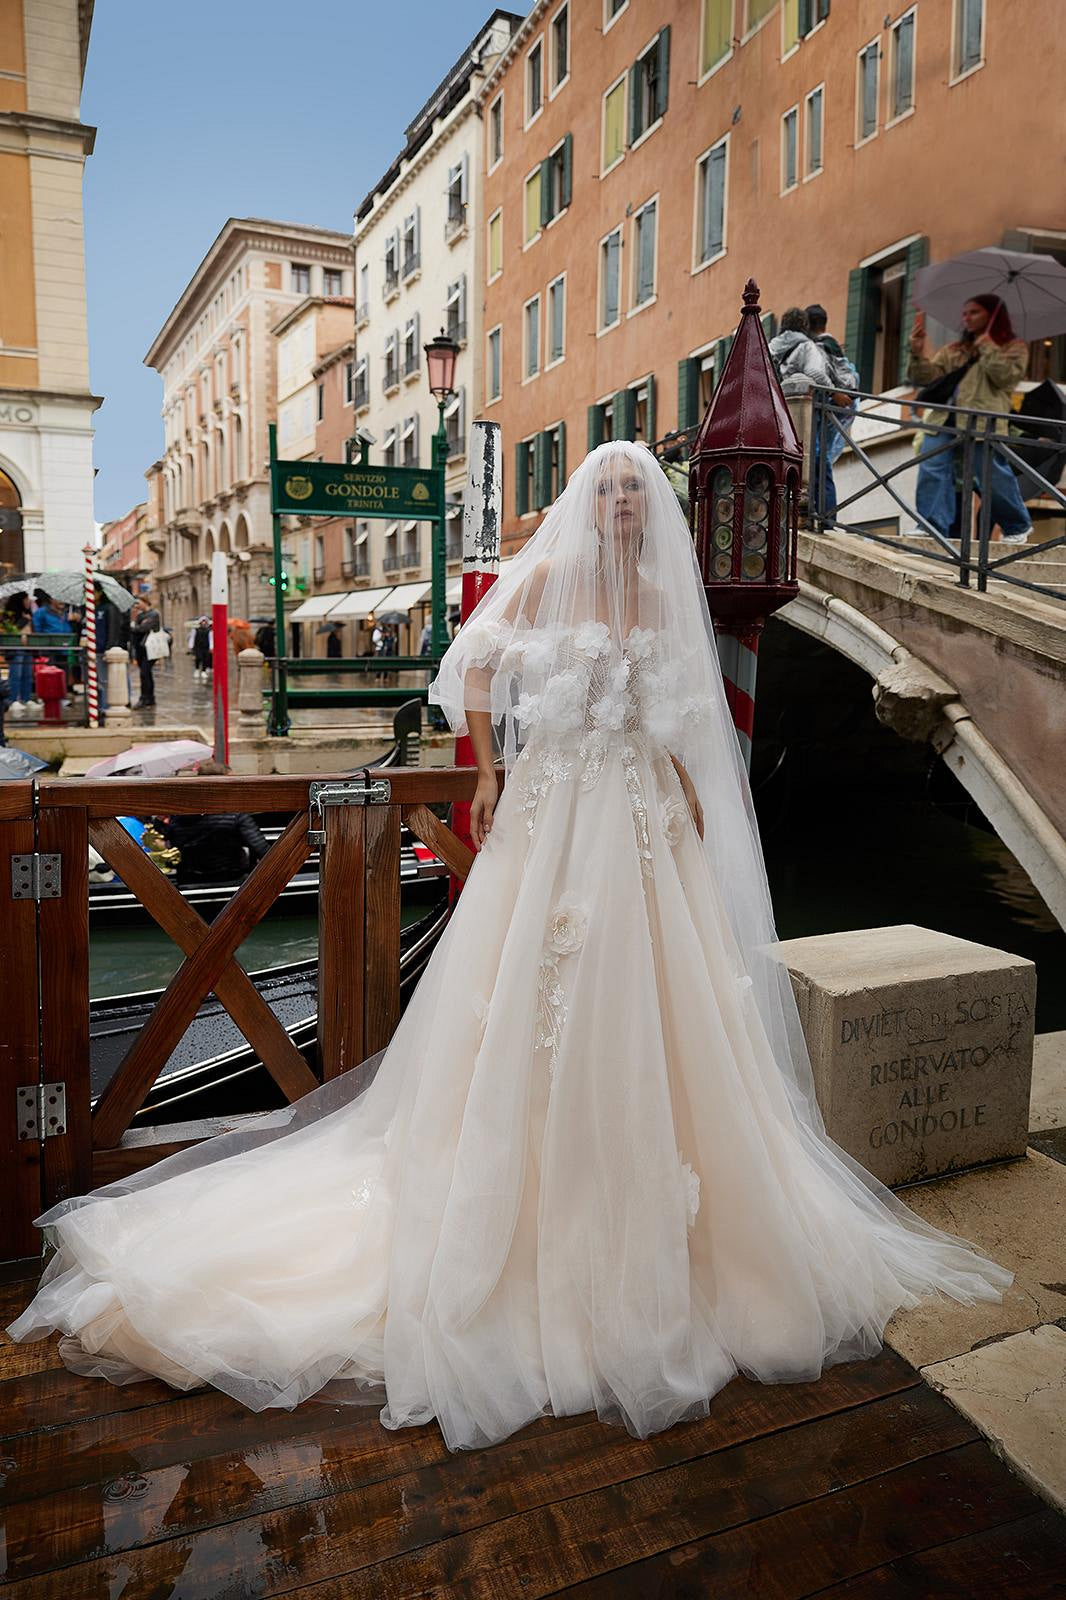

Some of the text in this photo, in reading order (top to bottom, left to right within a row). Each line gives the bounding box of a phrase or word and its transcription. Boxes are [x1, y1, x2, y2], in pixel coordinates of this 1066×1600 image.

[325, 484, 400, 498] GONDOLE
[344, 474, 386, 483] SERVIZIO
[841, 1008, 922, 1044] DIVIETO
[954, 993, 1030, 1024] SOSTA
[870, 1046, 988, 1087] RISERVATO
[900, 1082, 953, 1109] ALLE
[870, 1105, 986, 1149] GONDOLE
